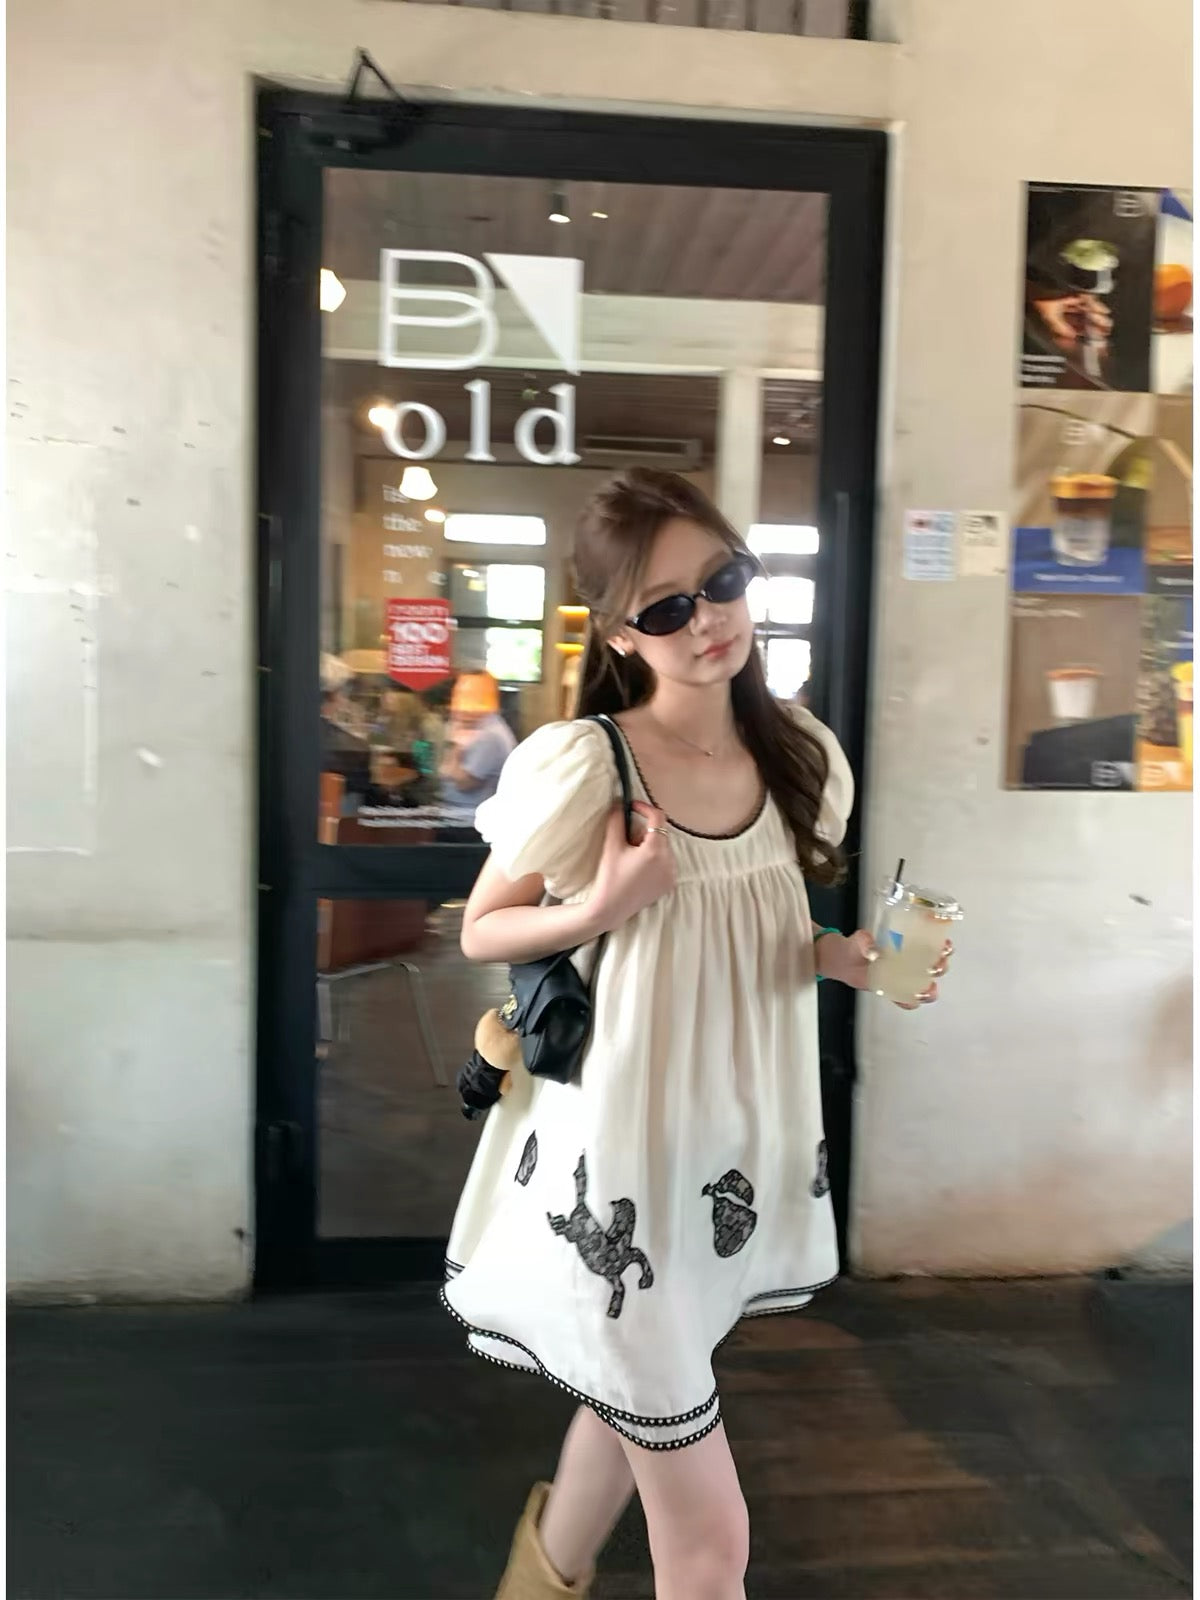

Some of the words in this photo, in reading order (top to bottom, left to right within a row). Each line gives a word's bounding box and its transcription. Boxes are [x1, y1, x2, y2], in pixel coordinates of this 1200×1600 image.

[380, 248, 499, 370] B
[381, 379, 582, 464] old
[389, 621, 450, 644] 100
